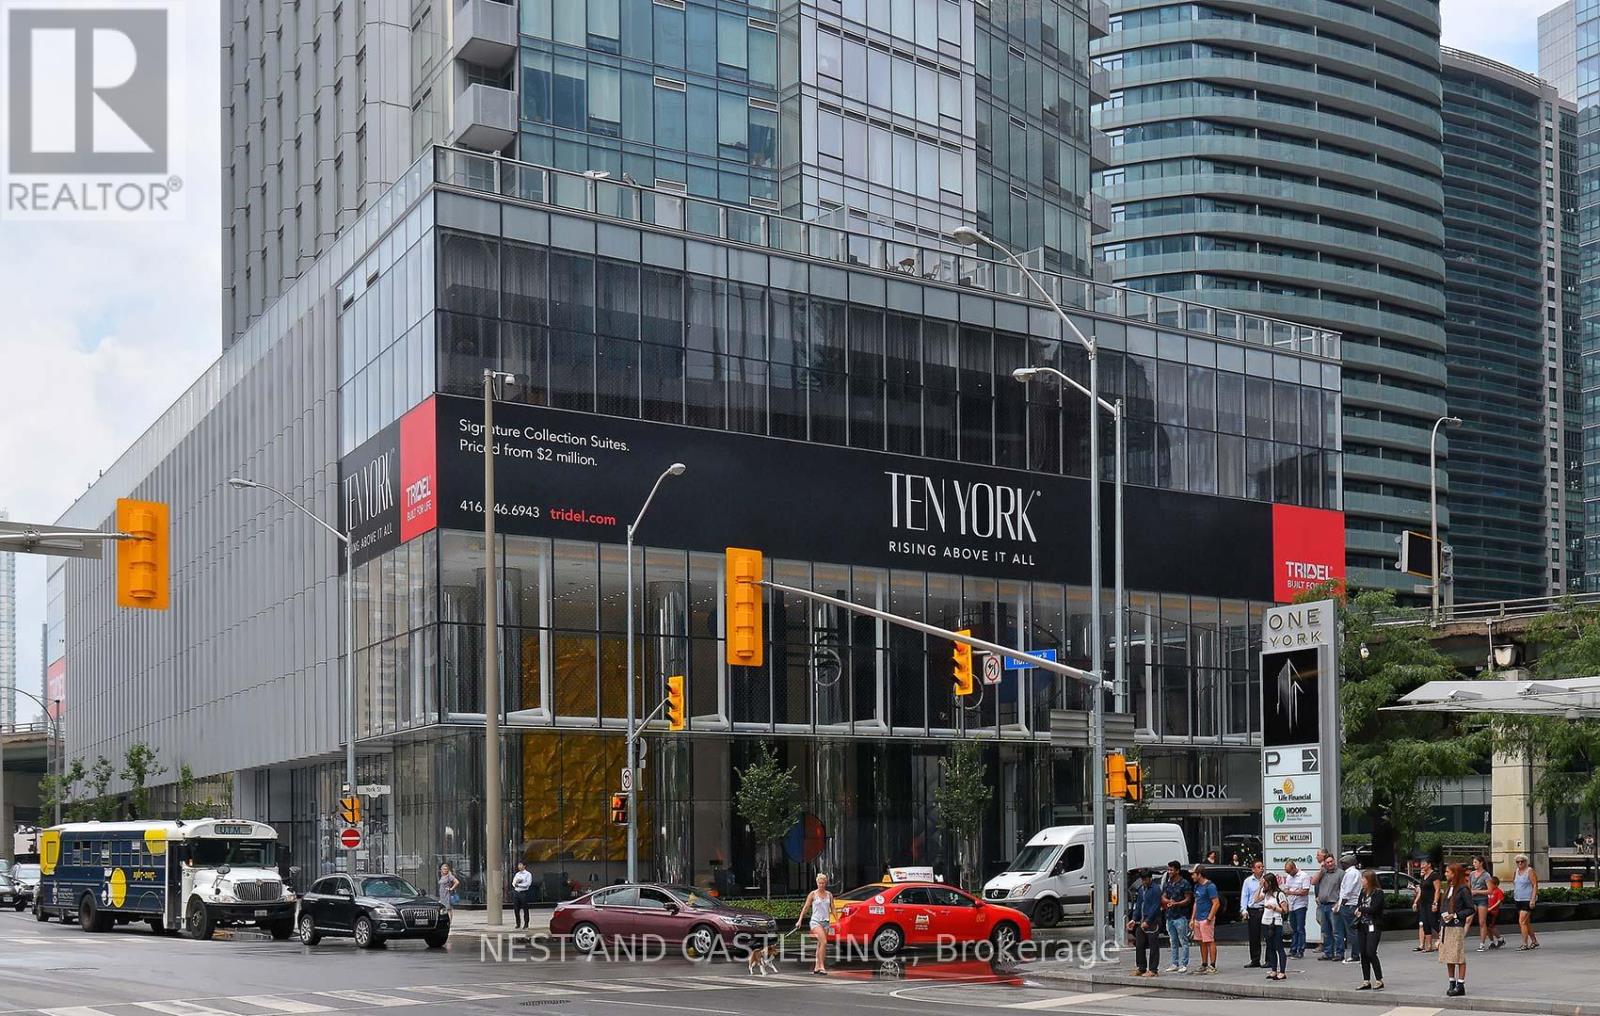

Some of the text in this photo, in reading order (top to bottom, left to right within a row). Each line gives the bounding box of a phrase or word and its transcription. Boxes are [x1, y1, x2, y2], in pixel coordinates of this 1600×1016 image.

[524, 426, 587, 446] Collection
[590, 434, 630, 452] Suites.
[460, 438, 598, 466] Pricd from $2 million.
[342, 470, 363, 532] TEN
[406, 476, 431, 507] TRIDEL
[407, 510, 416, 522] BUILT
[460, 500, 616, 526] 416.46.6943 tridel.com
[884, 471, 1037, 543] TEN YORK
[889, 541, 1035, 566] RISING ABOVE IT ALL
[1285, 561, 1333, 581] TRIDEL
[1287, 579, 1305, 589] BUILT
[1269, 608, 1321, 630] ONE
[1270, 630, 1321, 647] YORK
[1264, 751, 1280, 774] P
[1182, 784, 1227, 799] YORK
